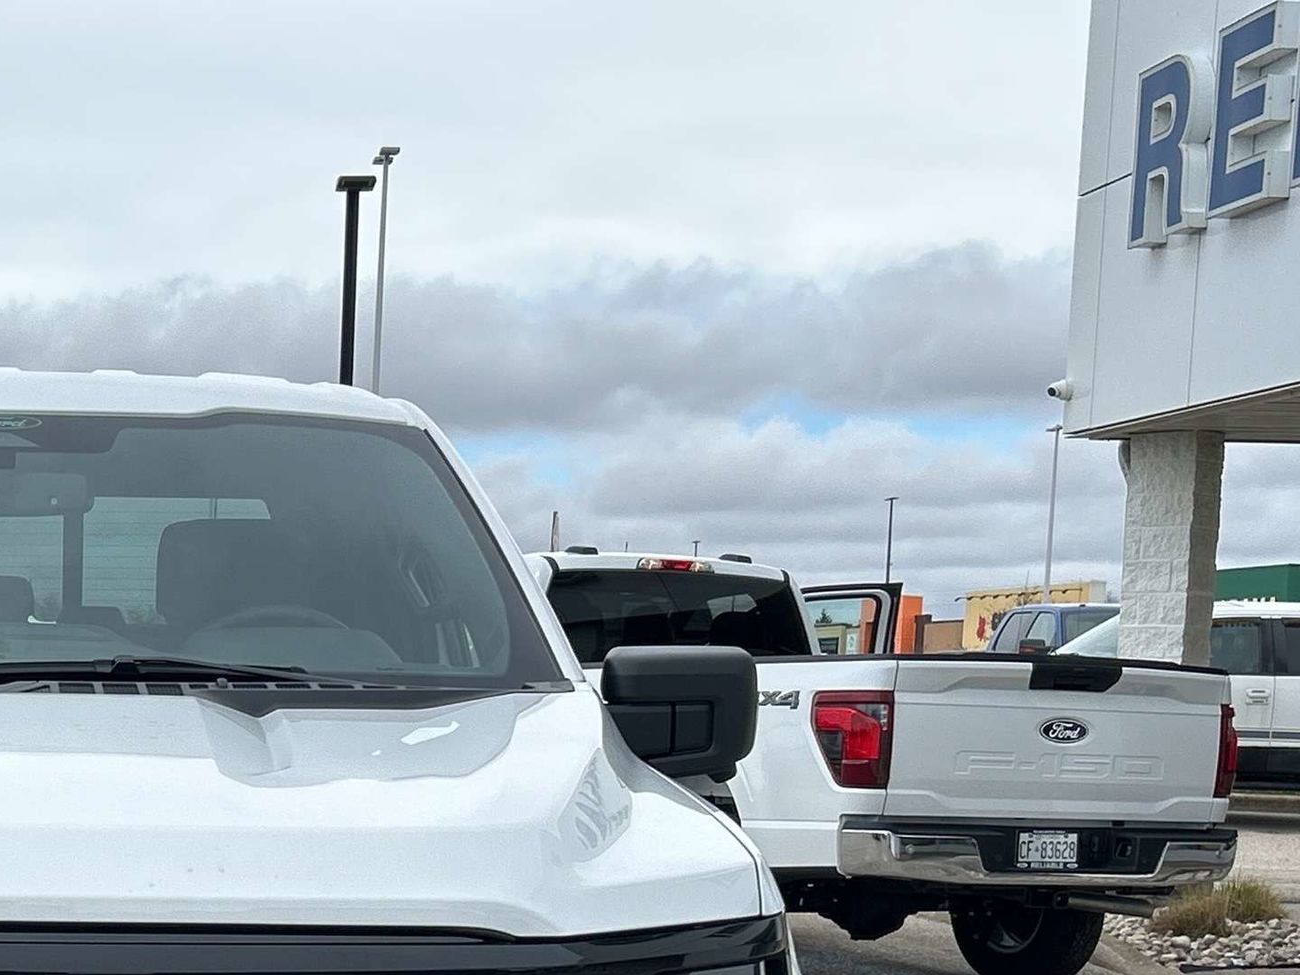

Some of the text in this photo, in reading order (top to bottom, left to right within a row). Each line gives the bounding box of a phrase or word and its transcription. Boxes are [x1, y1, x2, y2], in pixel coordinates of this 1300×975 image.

[1128, 0, 1300, 249] RE
[1049, 722, 1081, 739] Ford
[954, 750, 1165, 780] F-150
